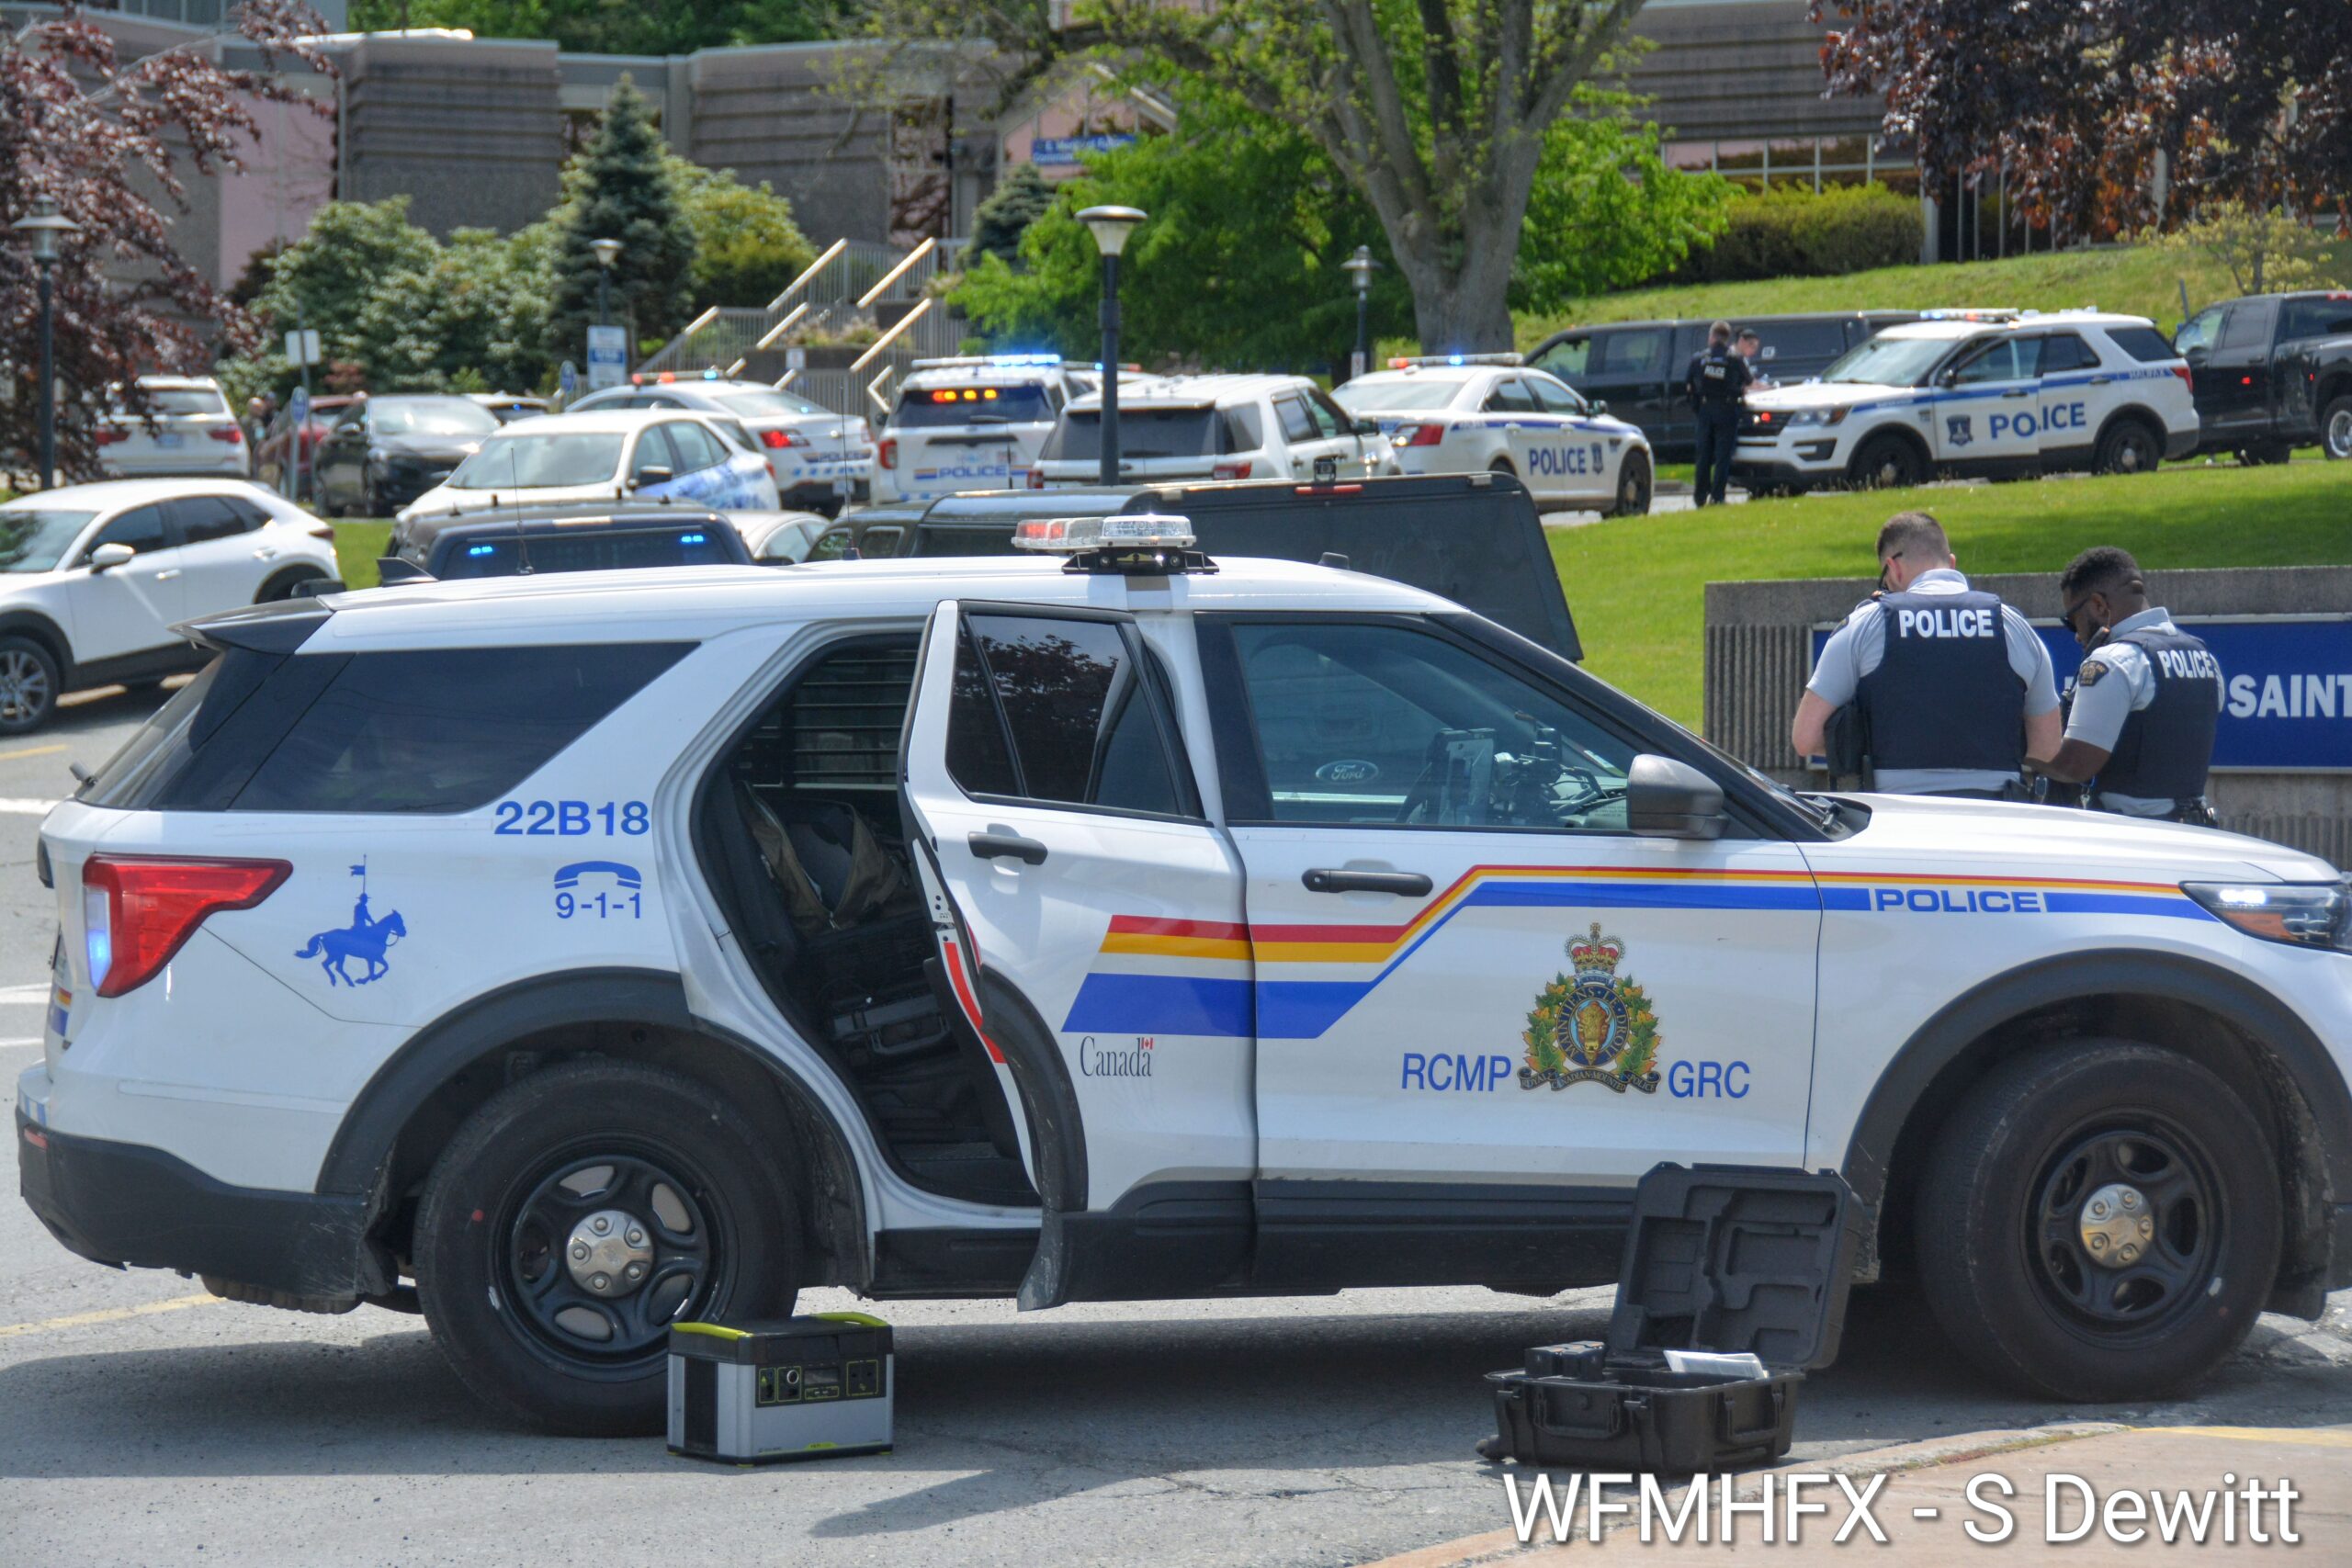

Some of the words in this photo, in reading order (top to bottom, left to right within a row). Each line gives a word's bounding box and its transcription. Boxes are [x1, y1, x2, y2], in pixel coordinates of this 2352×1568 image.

[1989, 401, 2086, 439] POICE
[938, 465, 1007, 478] POLICE
[1529, 447, 1587, 475] POLICE
[1899, 609, 1995, 638] POLICE
[2157, 650, 2215, 679] POLICE
[2227, 674, 2352, 718] SAINT
[1331, 764, 1365, 781] Ford
[494, 800, 650, 836] 22B18
[555, 892, 640, 919] 9-1-1
[1876, 888, 2042, 913] POLICE
[1080, 1035, 1152, 1077] Canada
[1401, 1053, 1511, 1091] RCMP
[1668, 1060, 1751, 1100] GRC
